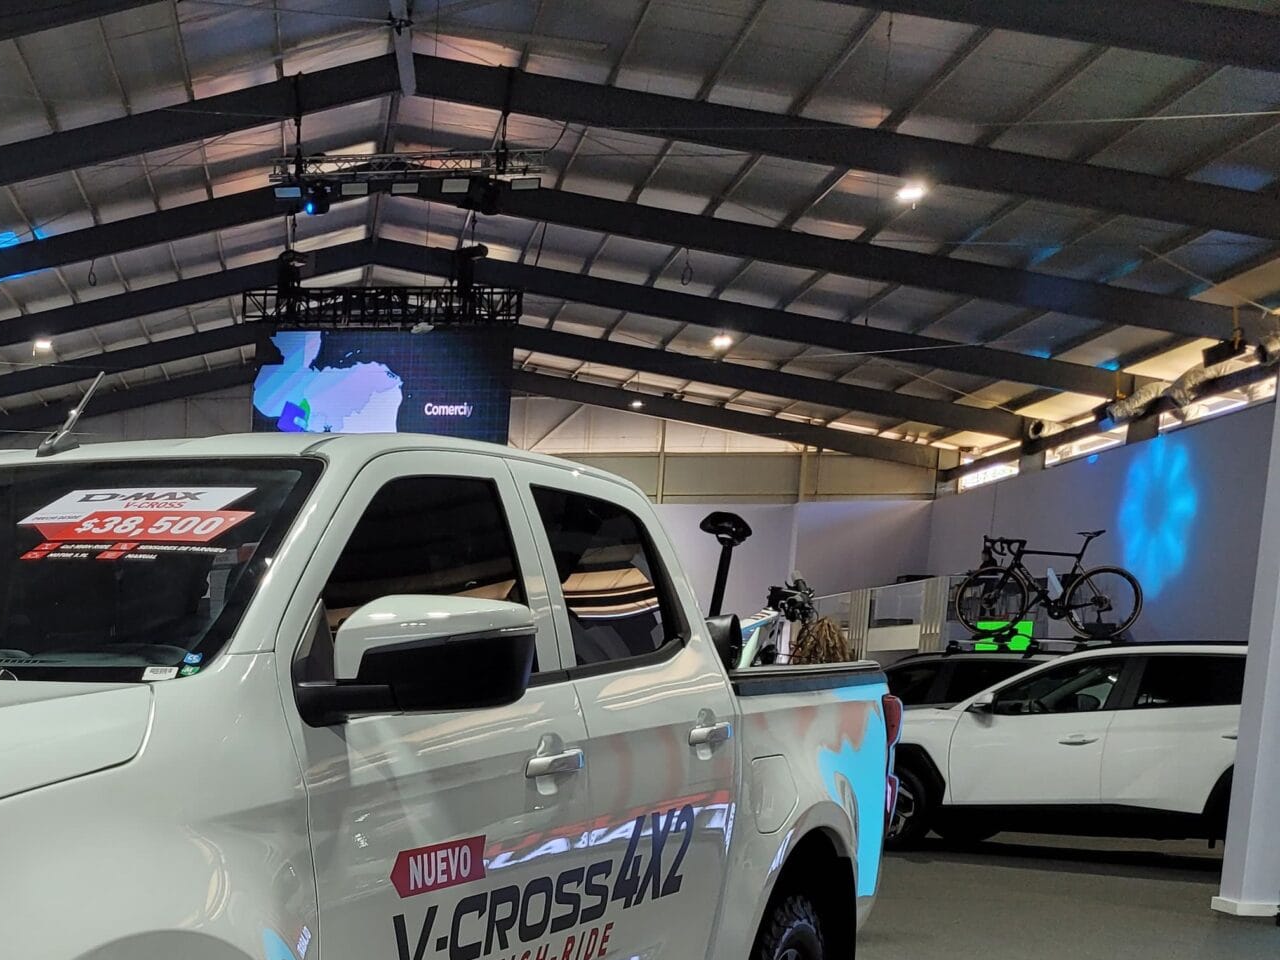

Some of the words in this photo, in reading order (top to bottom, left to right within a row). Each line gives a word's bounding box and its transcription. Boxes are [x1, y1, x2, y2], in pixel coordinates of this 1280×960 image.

[123, 501, 186, 509] V-CROSS
[408, 844, 472, 891] NUEVO
[610, 803, 695, 910] 4X2
